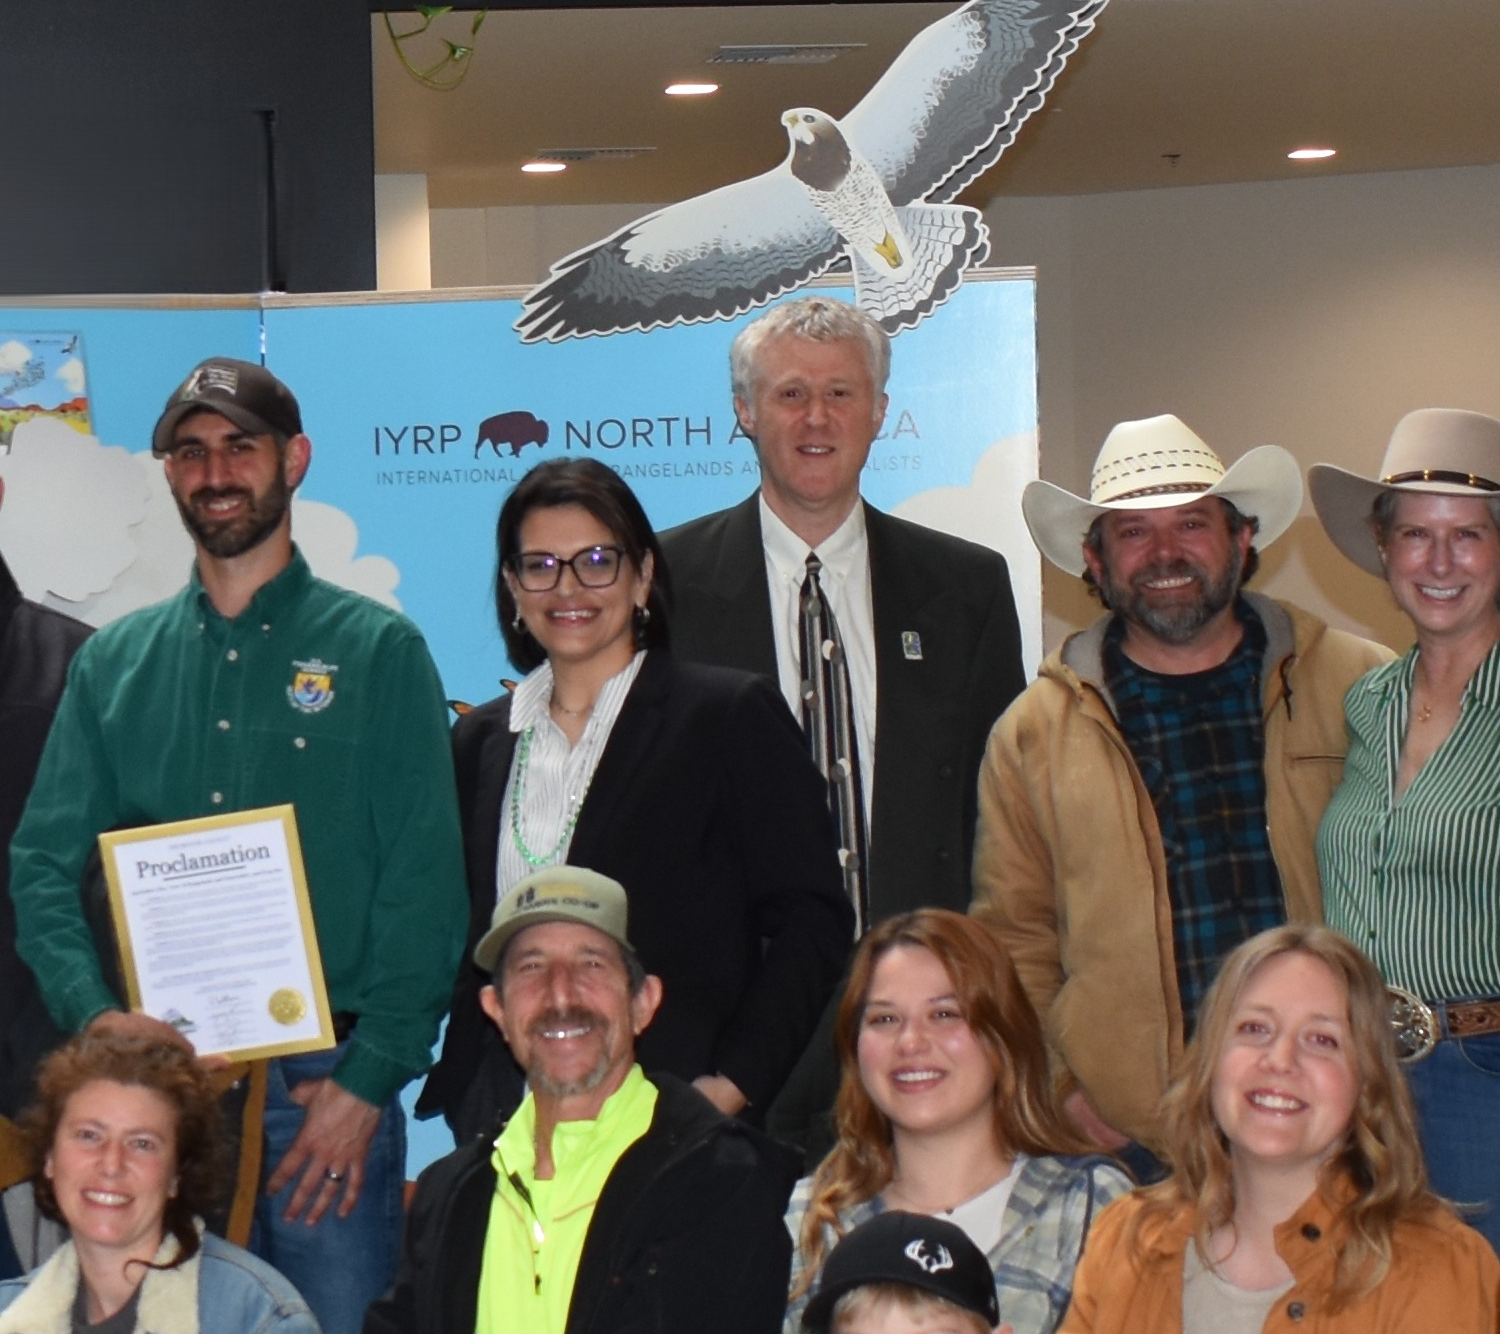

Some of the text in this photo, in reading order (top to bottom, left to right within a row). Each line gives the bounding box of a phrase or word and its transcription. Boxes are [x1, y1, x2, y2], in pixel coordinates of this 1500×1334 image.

[374, 424, 463, 457] IYRP
[565, 415, 712, 450] NORTH
[376, 468, 519, 486] INTERNATIONAL
[136, 844, 271, 880] Proclamation
